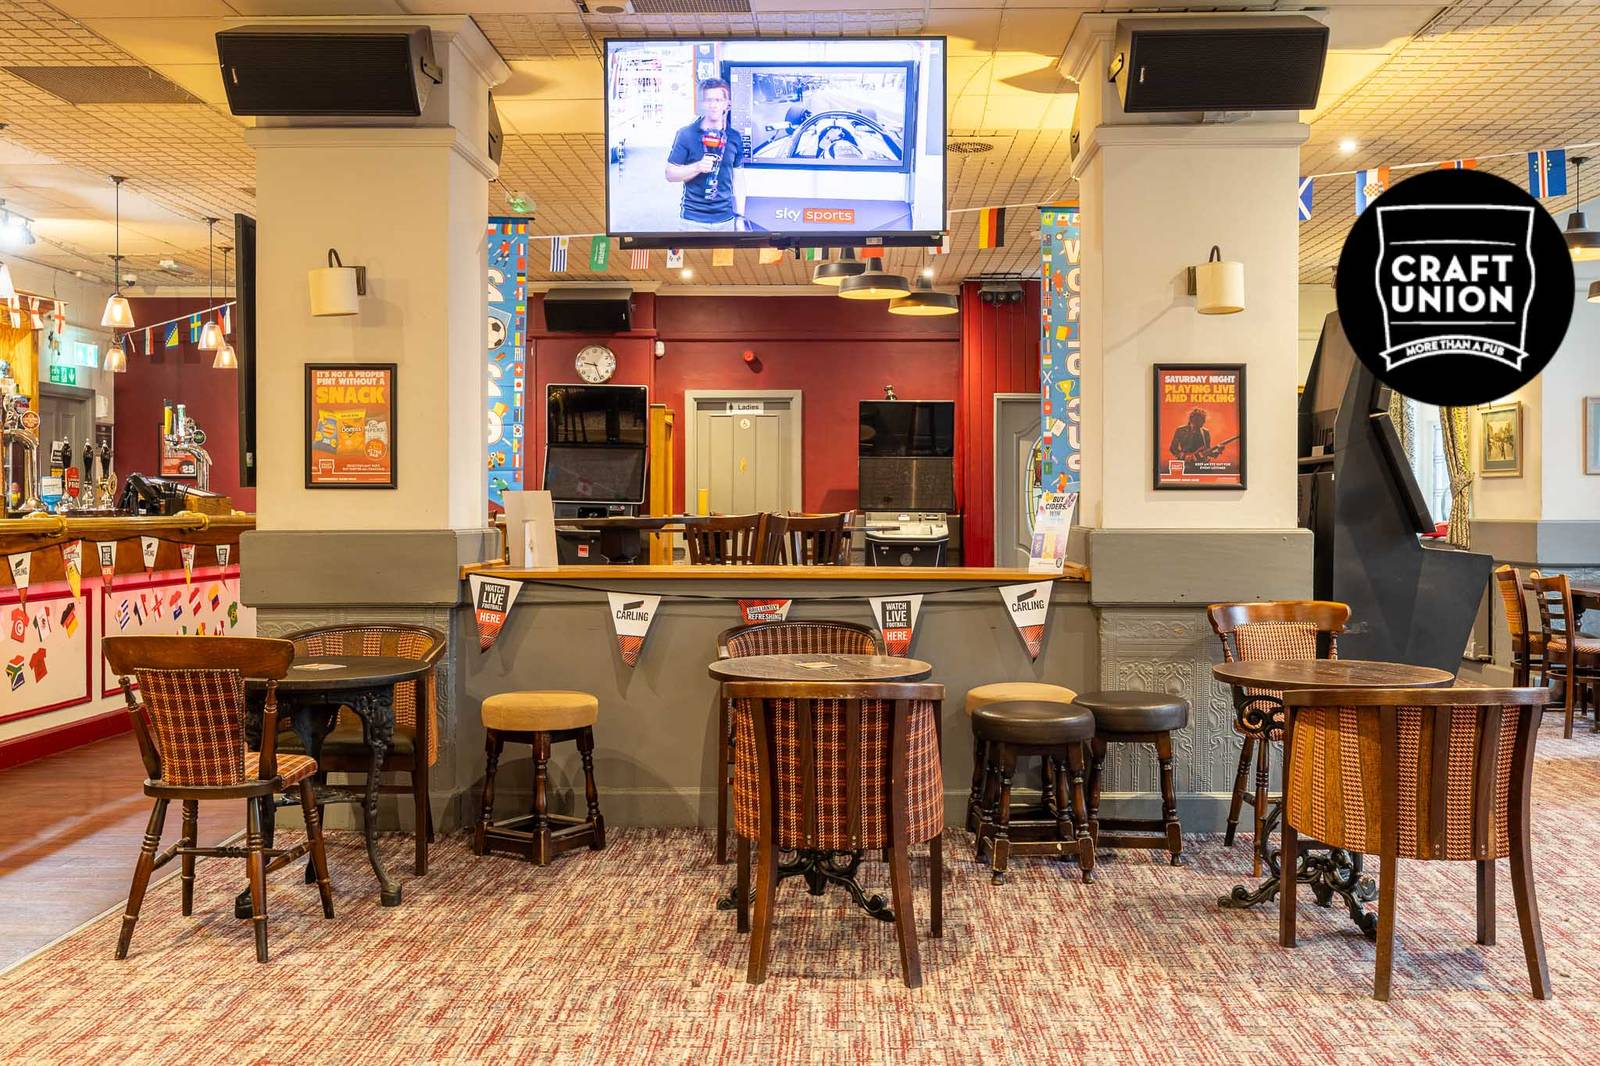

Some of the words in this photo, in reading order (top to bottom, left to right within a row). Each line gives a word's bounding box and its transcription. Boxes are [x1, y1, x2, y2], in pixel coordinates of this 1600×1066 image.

[775, 208, 800, 221] sky
[806, 210, 852, 221] sports
[317, 378, 337, 386] PINT
[339, 378, 377, 386] WITHOUT
[379, 378, 385, 386] A
[1165, 375, 1207, 384] SATURDAY
[1209, 375, 1236, 384] NIGHT
[1165, 384, 1211, 394] PLAYING
[1213, 384, 1236, 394] LIVE
[316, 386, 385, 404] SNACK
[1165, 394, 1188, 403] AND
[1191, 394, 1236, 403] KICKING
[484, 584, 506, 594] WATCH
[482, 592, 505, 605] LIVE
[481, 603, 503, 611] FOOTBALL
[886, 603, 907, 611] WATCH
[1011, 600, 1045, 612] CARLING
[480, 612, 501, 624] HERE
[616, 610, 649, 622] CARLING
[886, 611, 908, 622] LIVE
[887, 631, 908, 641] HERE
